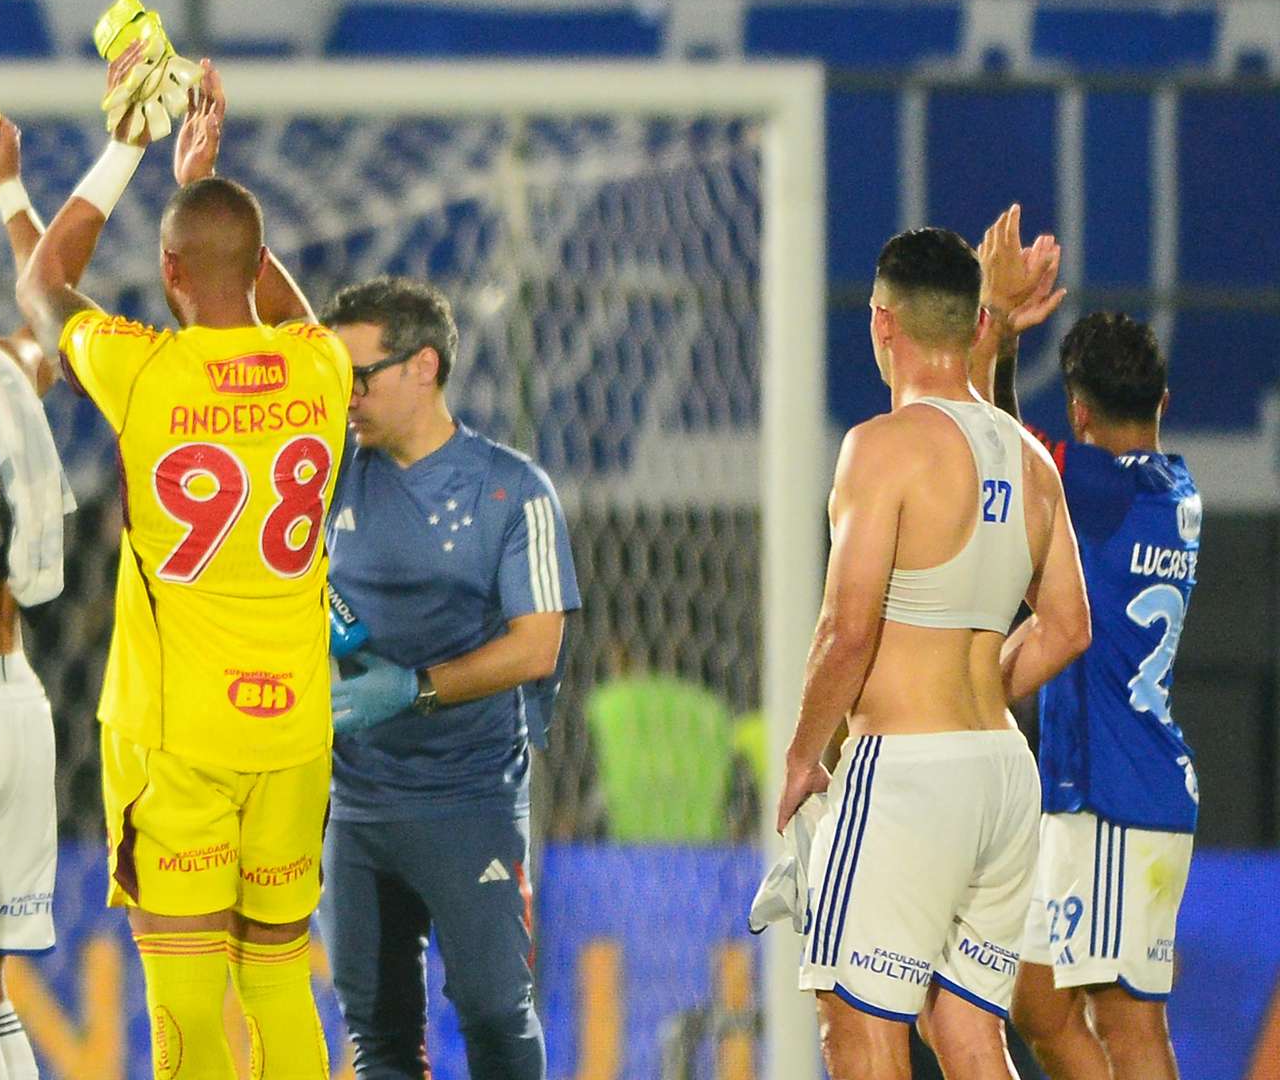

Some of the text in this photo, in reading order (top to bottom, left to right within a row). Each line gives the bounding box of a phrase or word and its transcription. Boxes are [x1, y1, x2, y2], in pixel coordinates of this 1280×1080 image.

[210, 362, 284, 388] Vilma
[170, 395, 328, 435] ANDERSON
[152, 436, 334, 584] 98
[982, 479, 1012, 523] 27
[1130, 542, 1188, 580] LUCAS
[1126, 584, 1185, 725] 2
[236, 682, 288, 709] BH
[1047, 896, 1085, 943] 29
